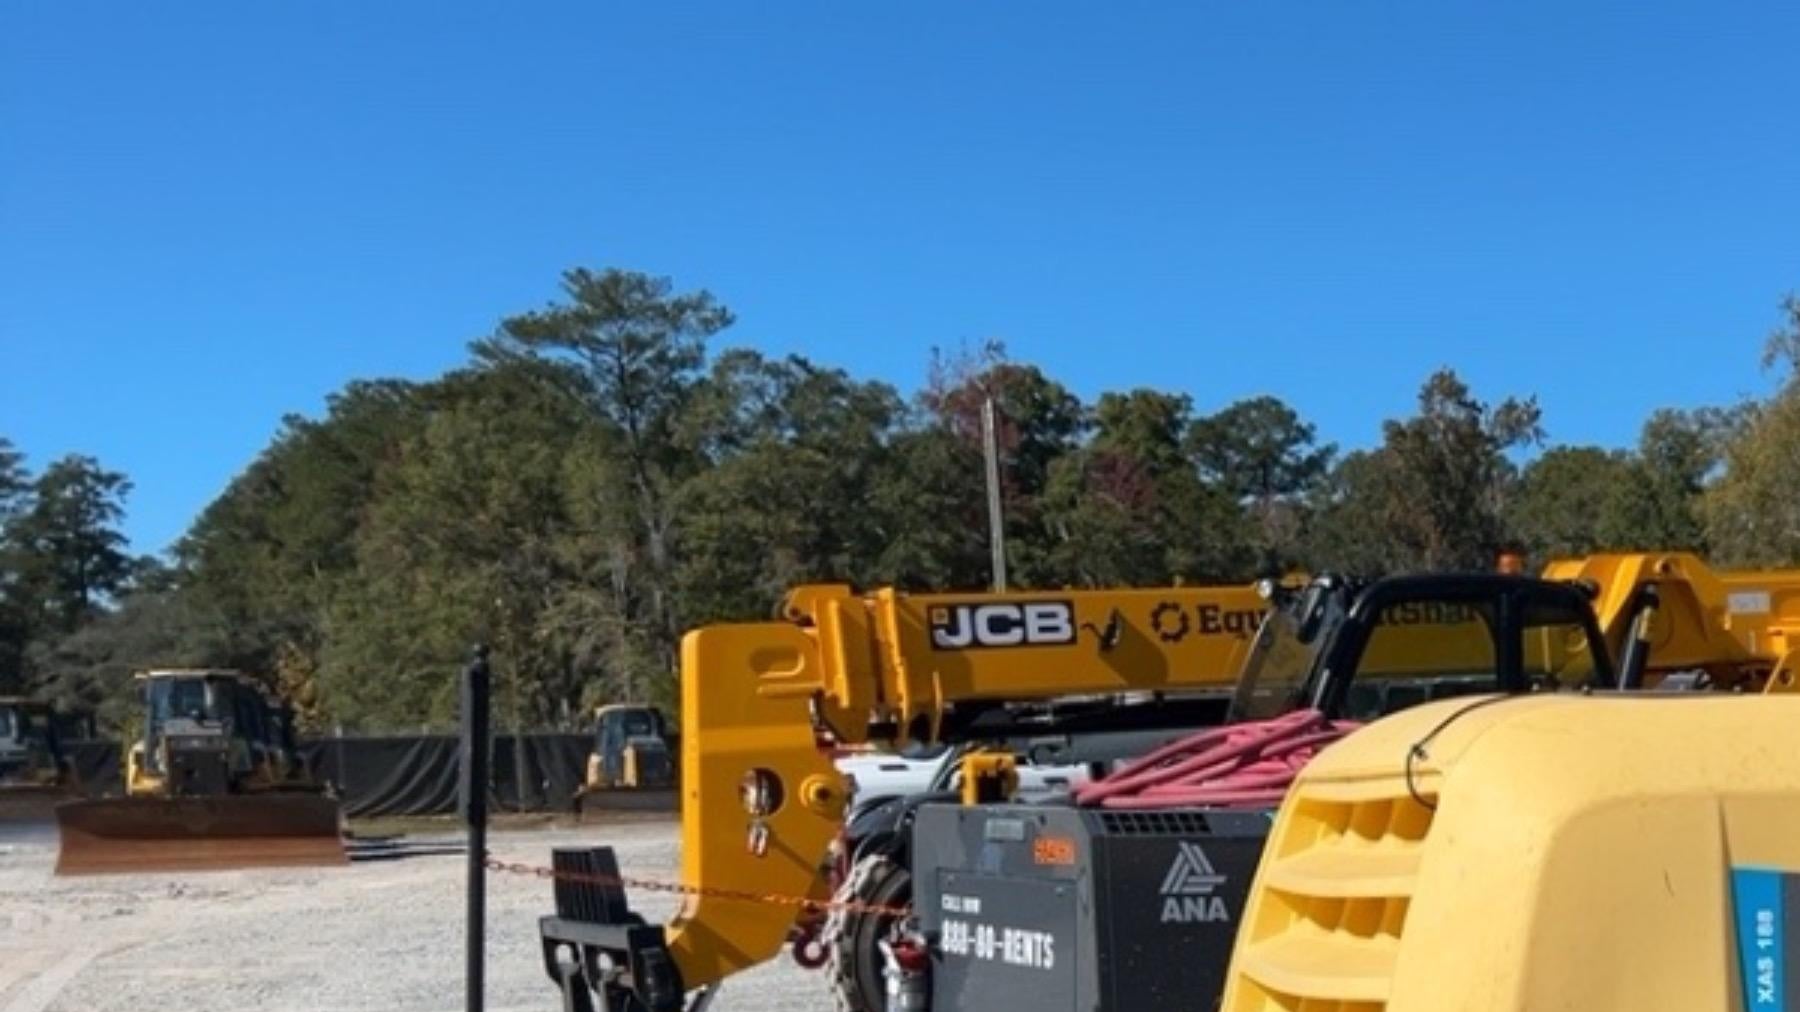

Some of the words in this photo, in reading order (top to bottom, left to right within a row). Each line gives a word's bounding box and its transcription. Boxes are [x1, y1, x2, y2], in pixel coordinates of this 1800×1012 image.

[932, 603, 1073, 647] JCB
[1160, 896, 1230, 923] ANA
[1756, 956, 1775, 1004] XAS
